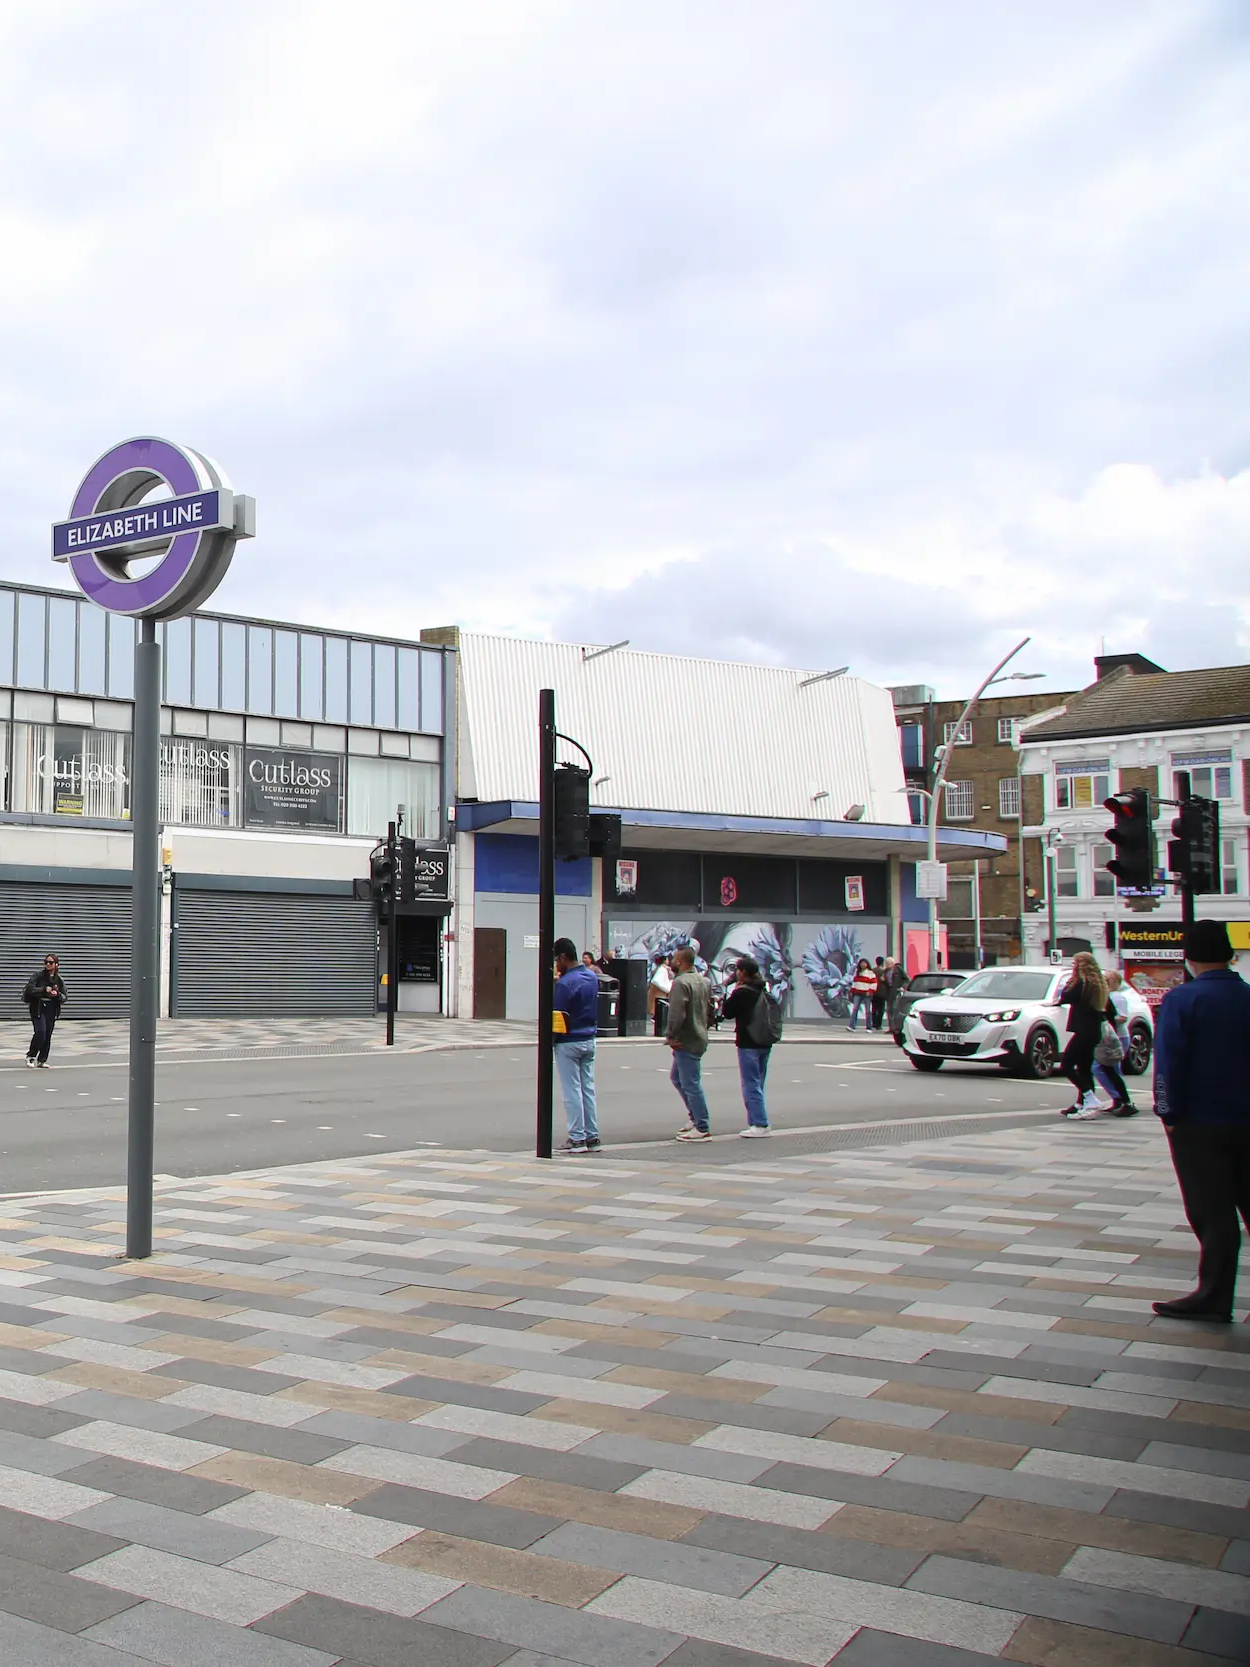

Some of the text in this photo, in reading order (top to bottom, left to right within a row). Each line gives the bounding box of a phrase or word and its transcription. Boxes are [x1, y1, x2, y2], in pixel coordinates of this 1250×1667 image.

[67, 501, 203, 547] ELIZABETH LINE
[37, 754, 127, 784] Cutlass
[159, 742, 230, 769] utlass
[249, 758, 331, 788] Cutlass
[261, 784, 320, 796] SECURITY GROUP
[1118, 931, 1184, 941] WesternUn
